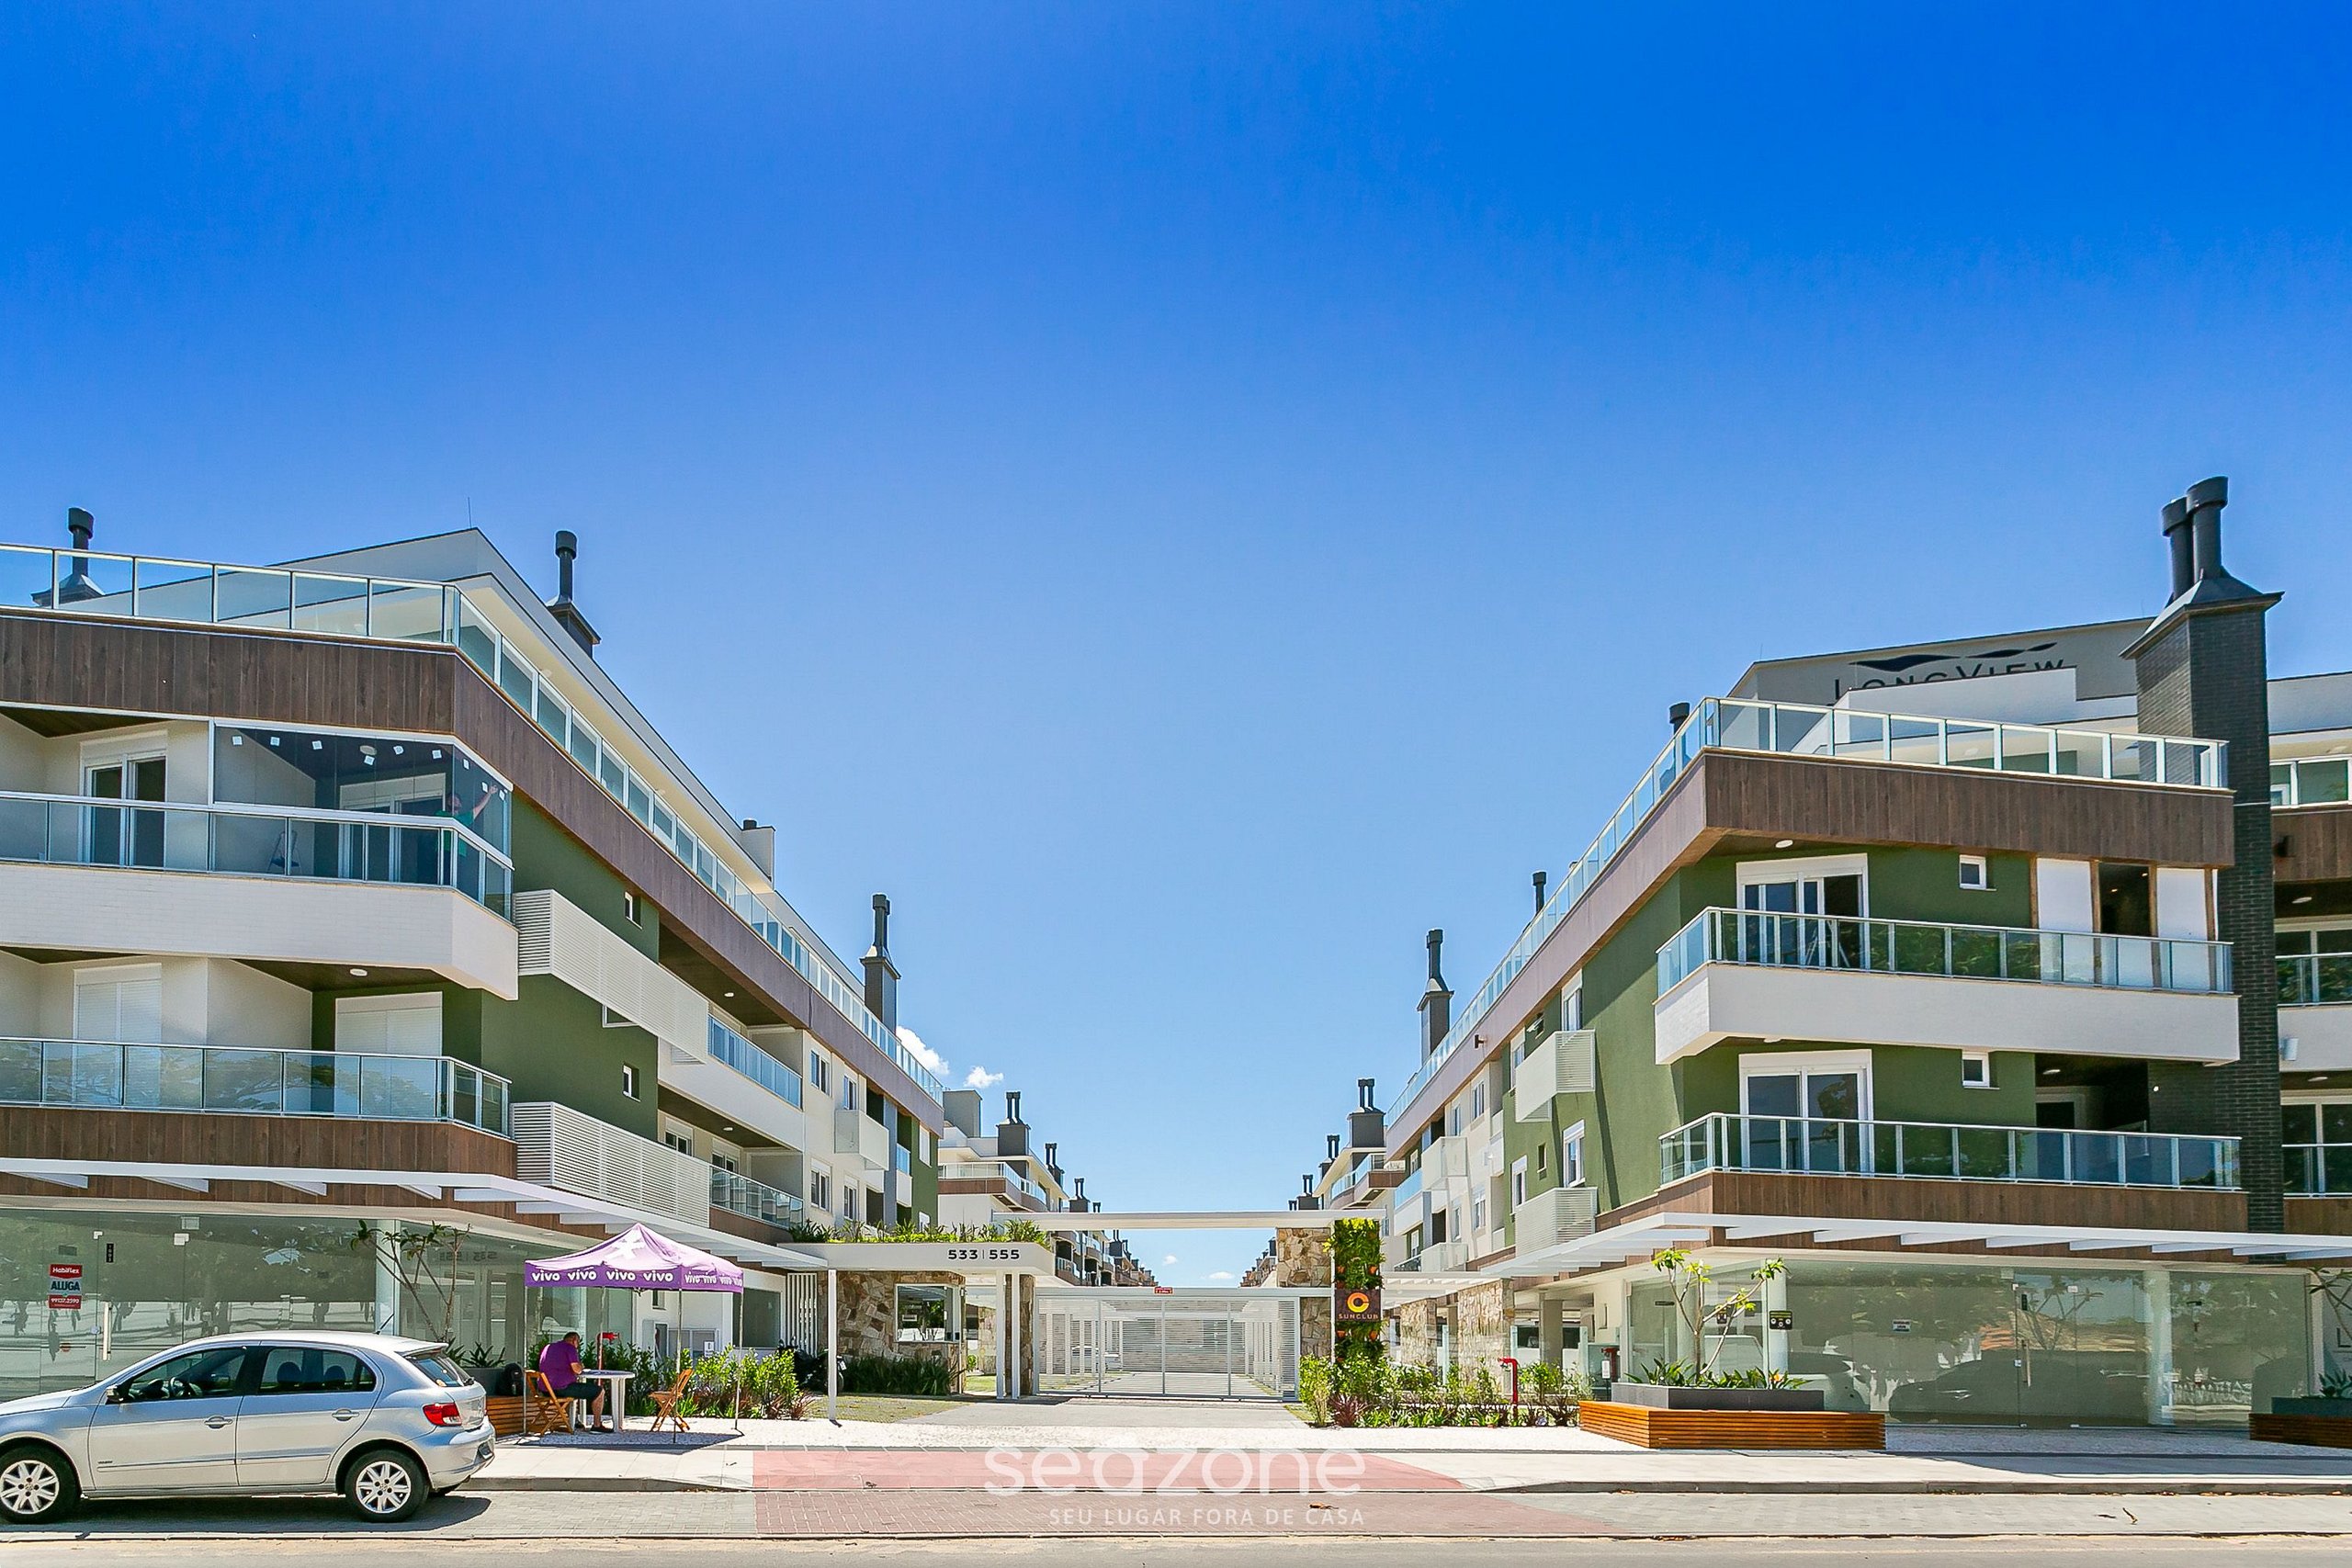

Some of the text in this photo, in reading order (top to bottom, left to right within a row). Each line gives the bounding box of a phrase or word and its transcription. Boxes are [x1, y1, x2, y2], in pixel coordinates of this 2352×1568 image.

[948, 1249, 978, 1259] 533
[989, 1249, 1020, 1259] 555
[531, 1269, 673, 1282] vivo vivo vivo vivo
[684, 1271, 701, 1284] vivo
[51, 1281, 80, 1291] ALUGA
